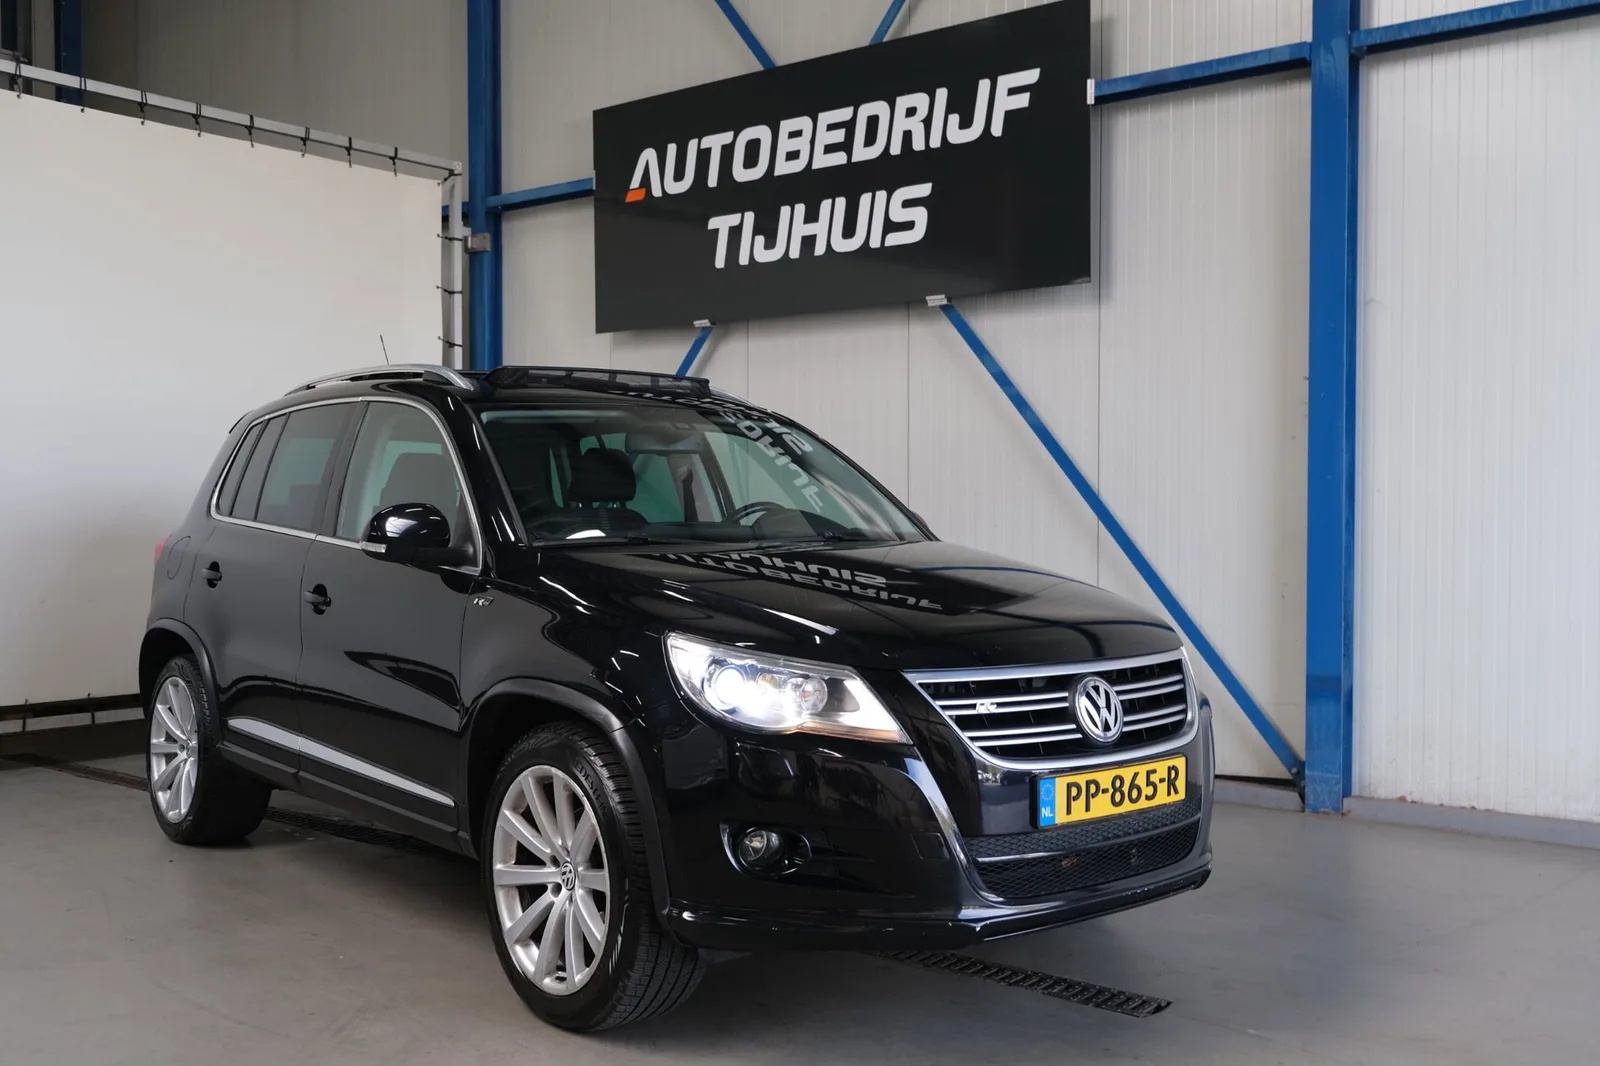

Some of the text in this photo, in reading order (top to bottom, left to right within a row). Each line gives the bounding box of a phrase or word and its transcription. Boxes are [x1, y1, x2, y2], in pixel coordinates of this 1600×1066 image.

[625, 67, 1041, 203] AUTOBEDRIJF
[707, 182, 933, 269] TIJHUIS
[1041, 806, 1053, 818] NL
[1066, 765, 1180, 816] PP-865-R
